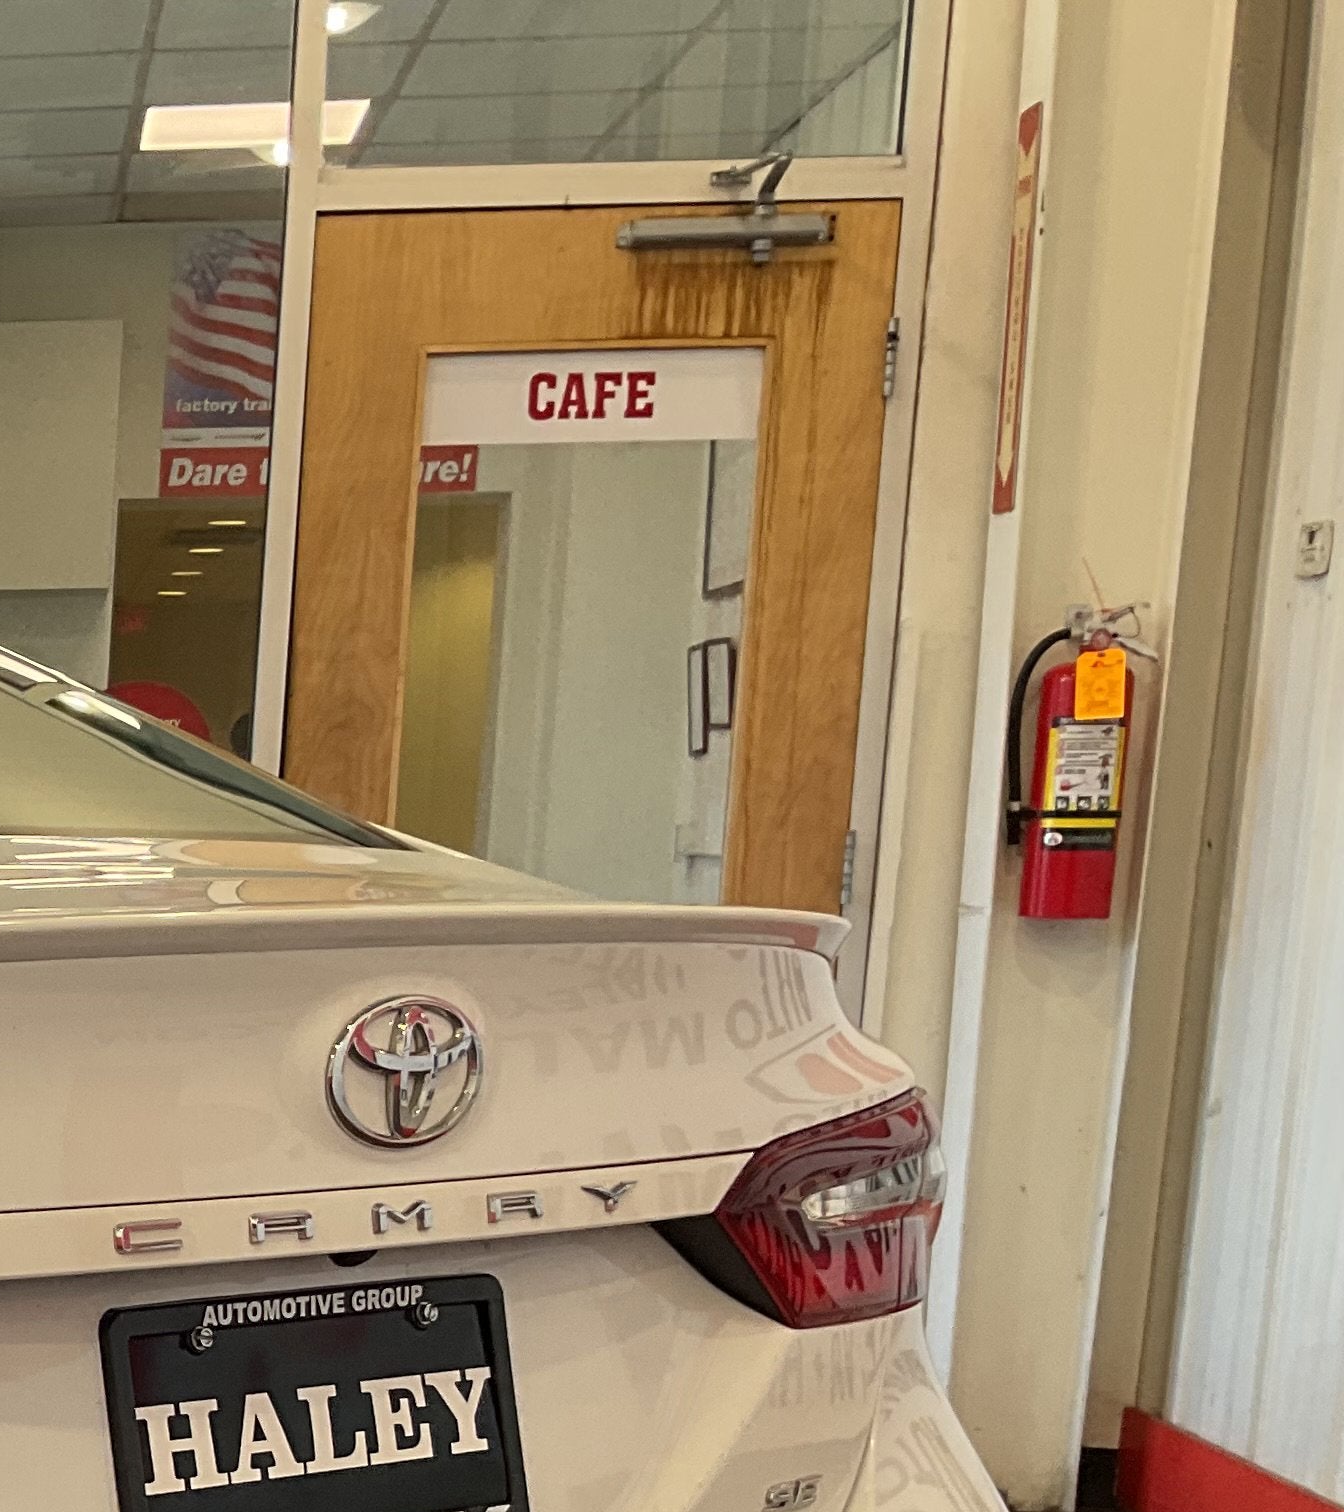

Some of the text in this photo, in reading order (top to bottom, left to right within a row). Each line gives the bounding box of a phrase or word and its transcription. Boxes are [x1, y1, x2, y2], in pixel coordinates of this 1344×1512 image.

[176, 398, 238, 415] factory
[527, 372, 656, 421] CAFE
[168, 457, 248, 487] Dare
[418, 453, 472, 483] re!
[113, 1180, 638, 1255] CAMRY
[201, 1284, 424, 1328] AUTOMOTIVE GROUP
[134, 1366, 492, 1497] HALEY
